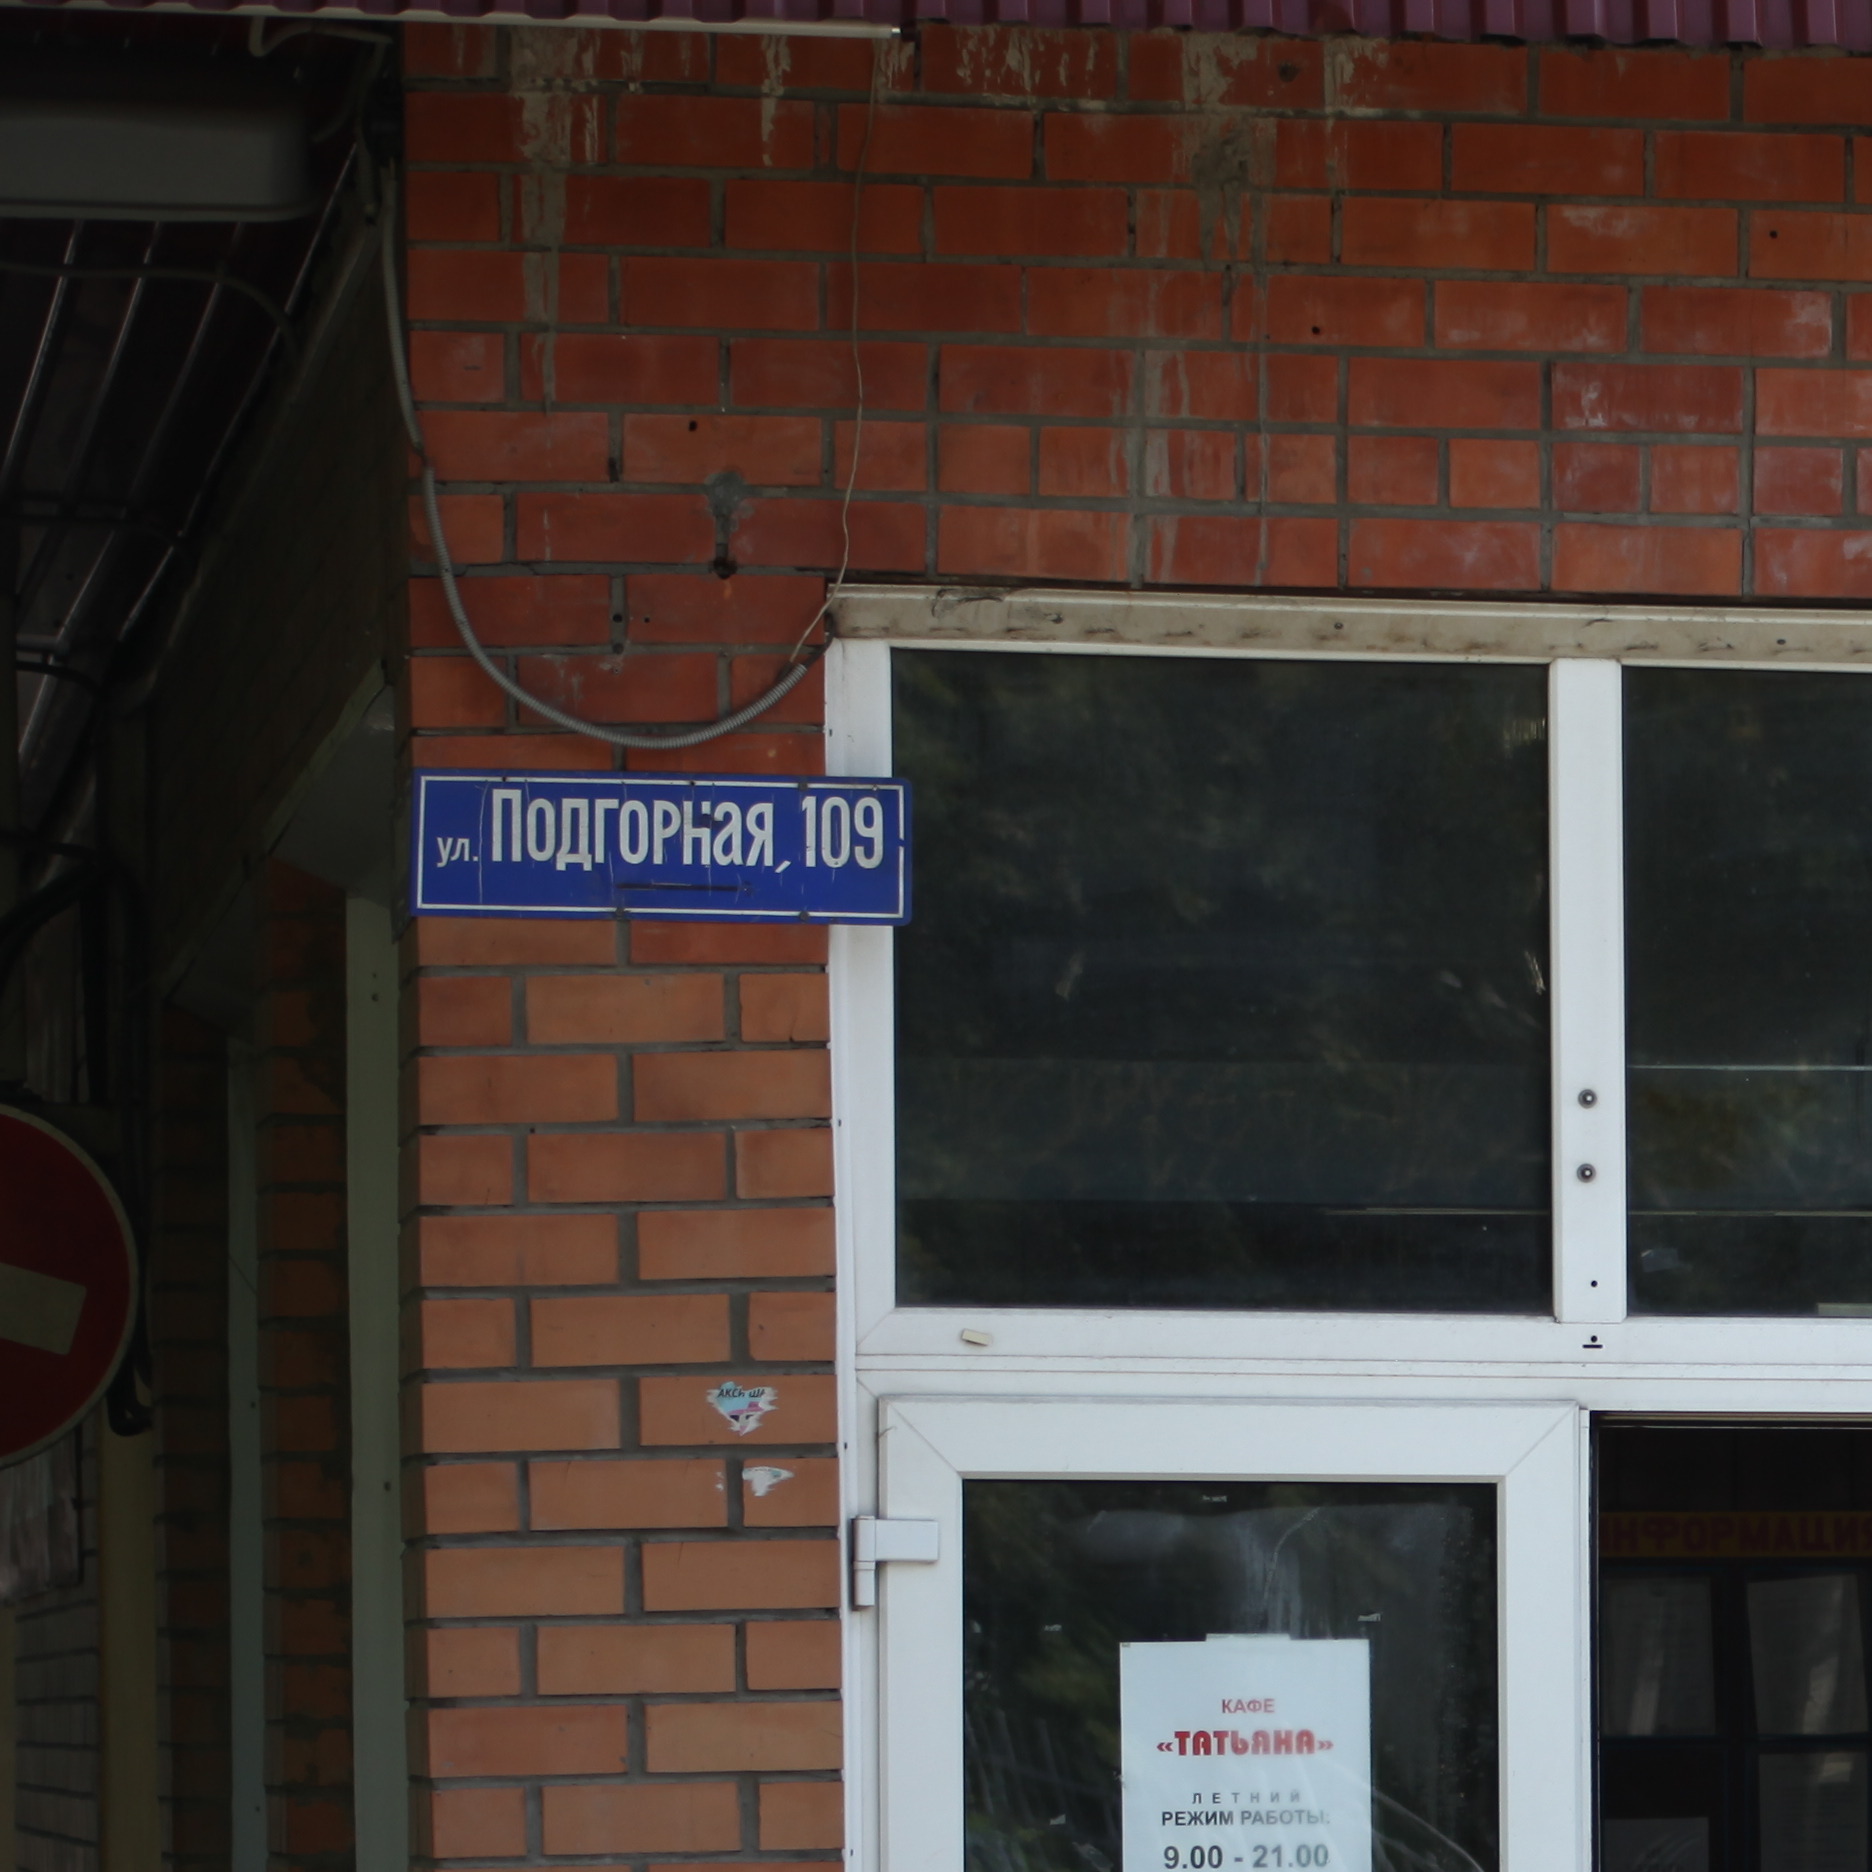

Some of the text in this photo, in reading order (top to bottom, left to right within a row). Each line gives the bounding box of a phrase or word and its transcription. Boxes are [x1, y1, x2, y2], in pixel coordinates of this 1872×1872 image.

[436, 836, 479, 868] ул.
[801, 795, 884, 869] 109
[1221, 1698, 1275, 1714] КАФЕ
[1161, 1808, 1331, 1827] РЕЖИМ РАБОТЫ:
[1163, 1844, 1224, 1869] 9.00
[1252, 1843, 1331, 1869] 21.00
